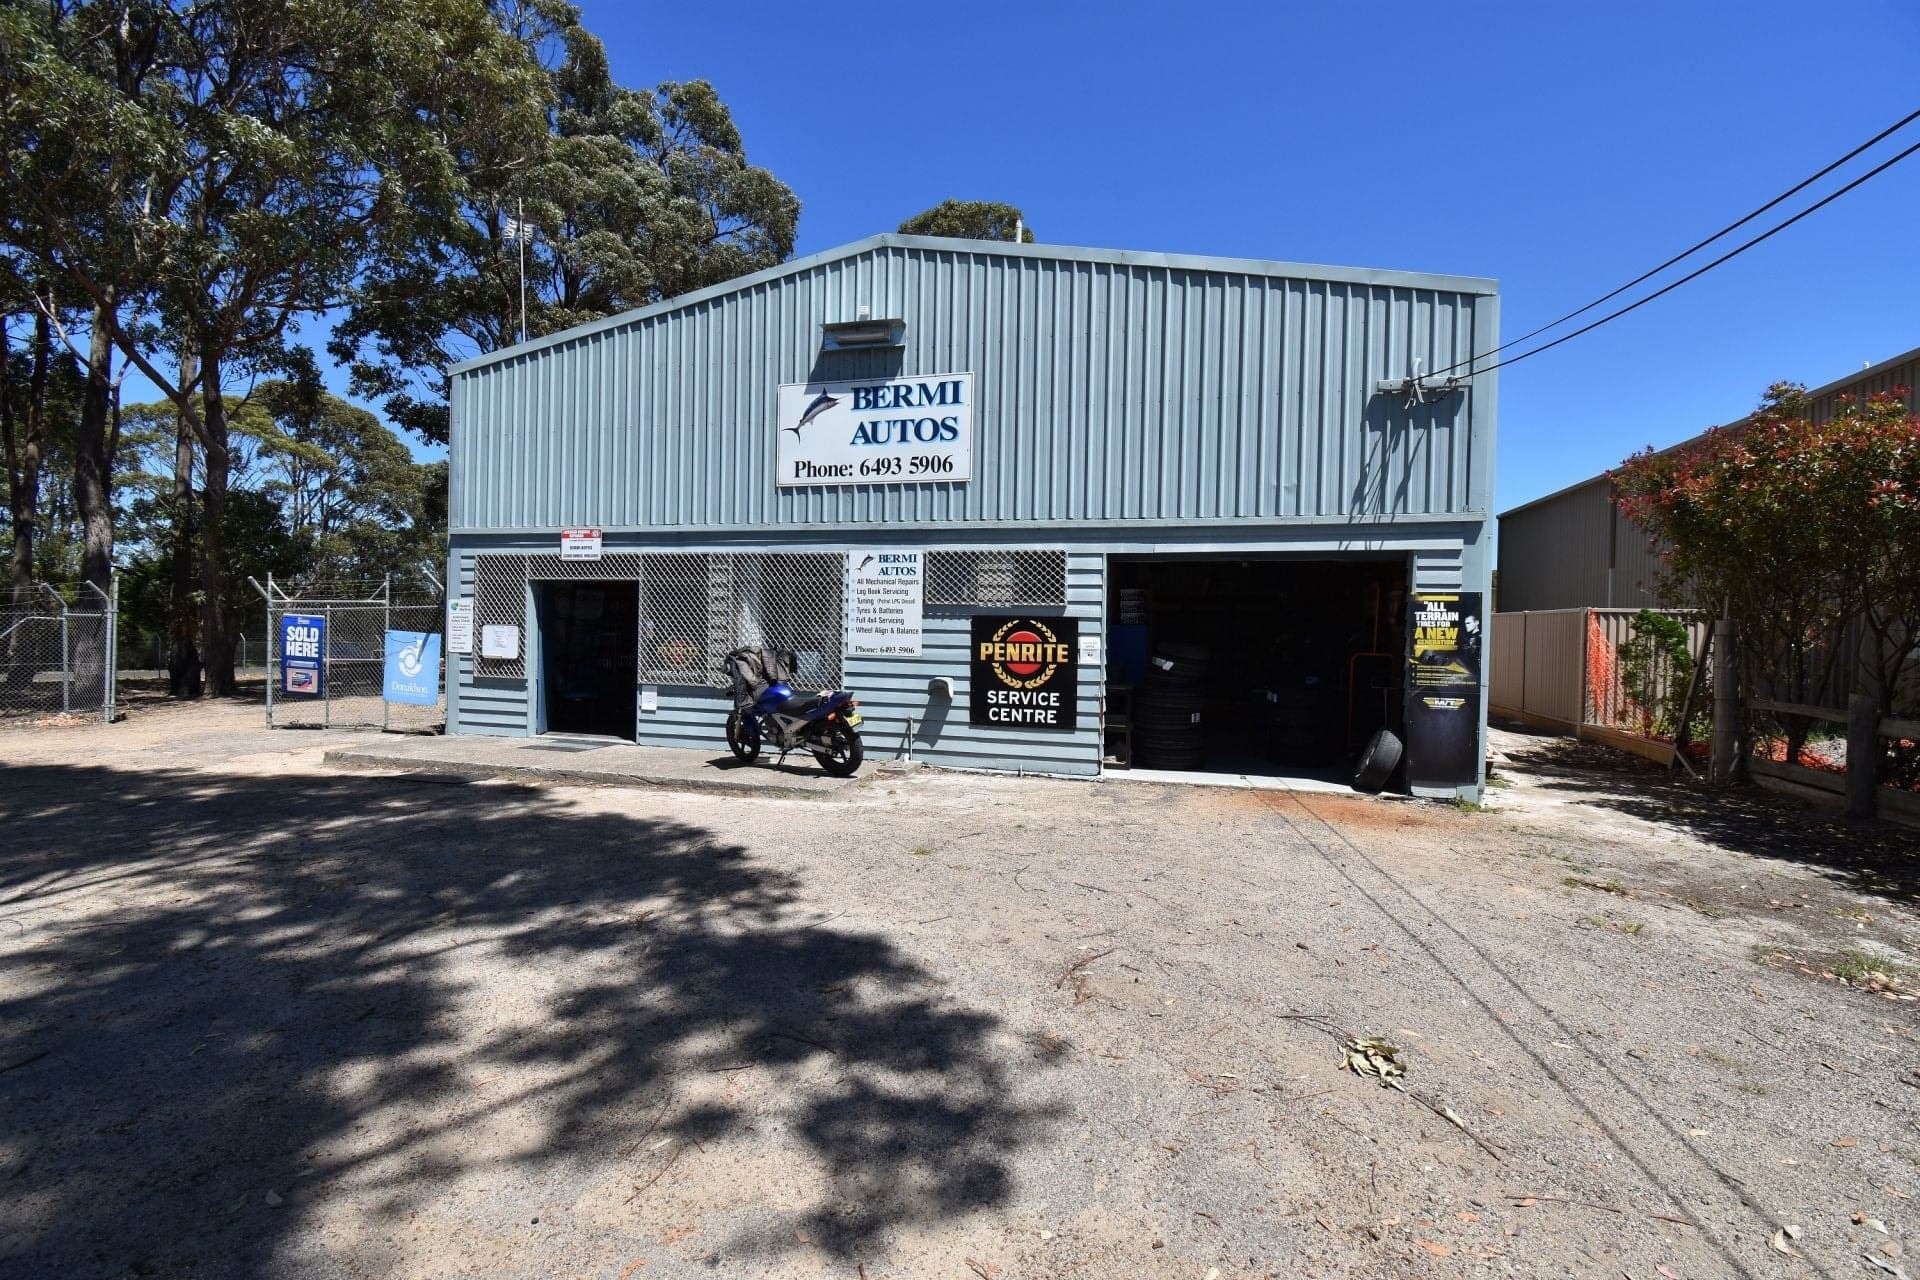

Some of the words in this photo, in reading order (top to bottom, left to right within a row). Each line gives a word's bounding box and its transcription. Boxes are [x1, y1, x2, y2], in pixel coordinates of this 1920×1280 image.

[851, 381, 964, 410] BERMI
[850, 416, 958, 445] AUTOS
[794, 460, 853, 478] Phone:
[859, 457, 901, 476] 6493
[909, 455, 953, 474] 5906
[878, 554, 917, 563] BERMI
[878, 567, 916, 576] AUTOS
[883, 588, 909, 596] Servicing
[857, 607, 870, 615] Tyres
[1414, 611, 1459, 621] TERRAIN
[879, 617, 904, 625] Servicing
[287, 626, 319, 642] SOLD
[875, 627, 888, 635] Align
[1414, 627, 1424, 639] A
[1426, 627, 1458, 639] NEW
[286, 641, 319, 658] HERE
[980, 642, 1069, 662] PENRITE
[987, 690, 1060, 706] SERVICE
[989, 707, 1057, 724] CENTRE
